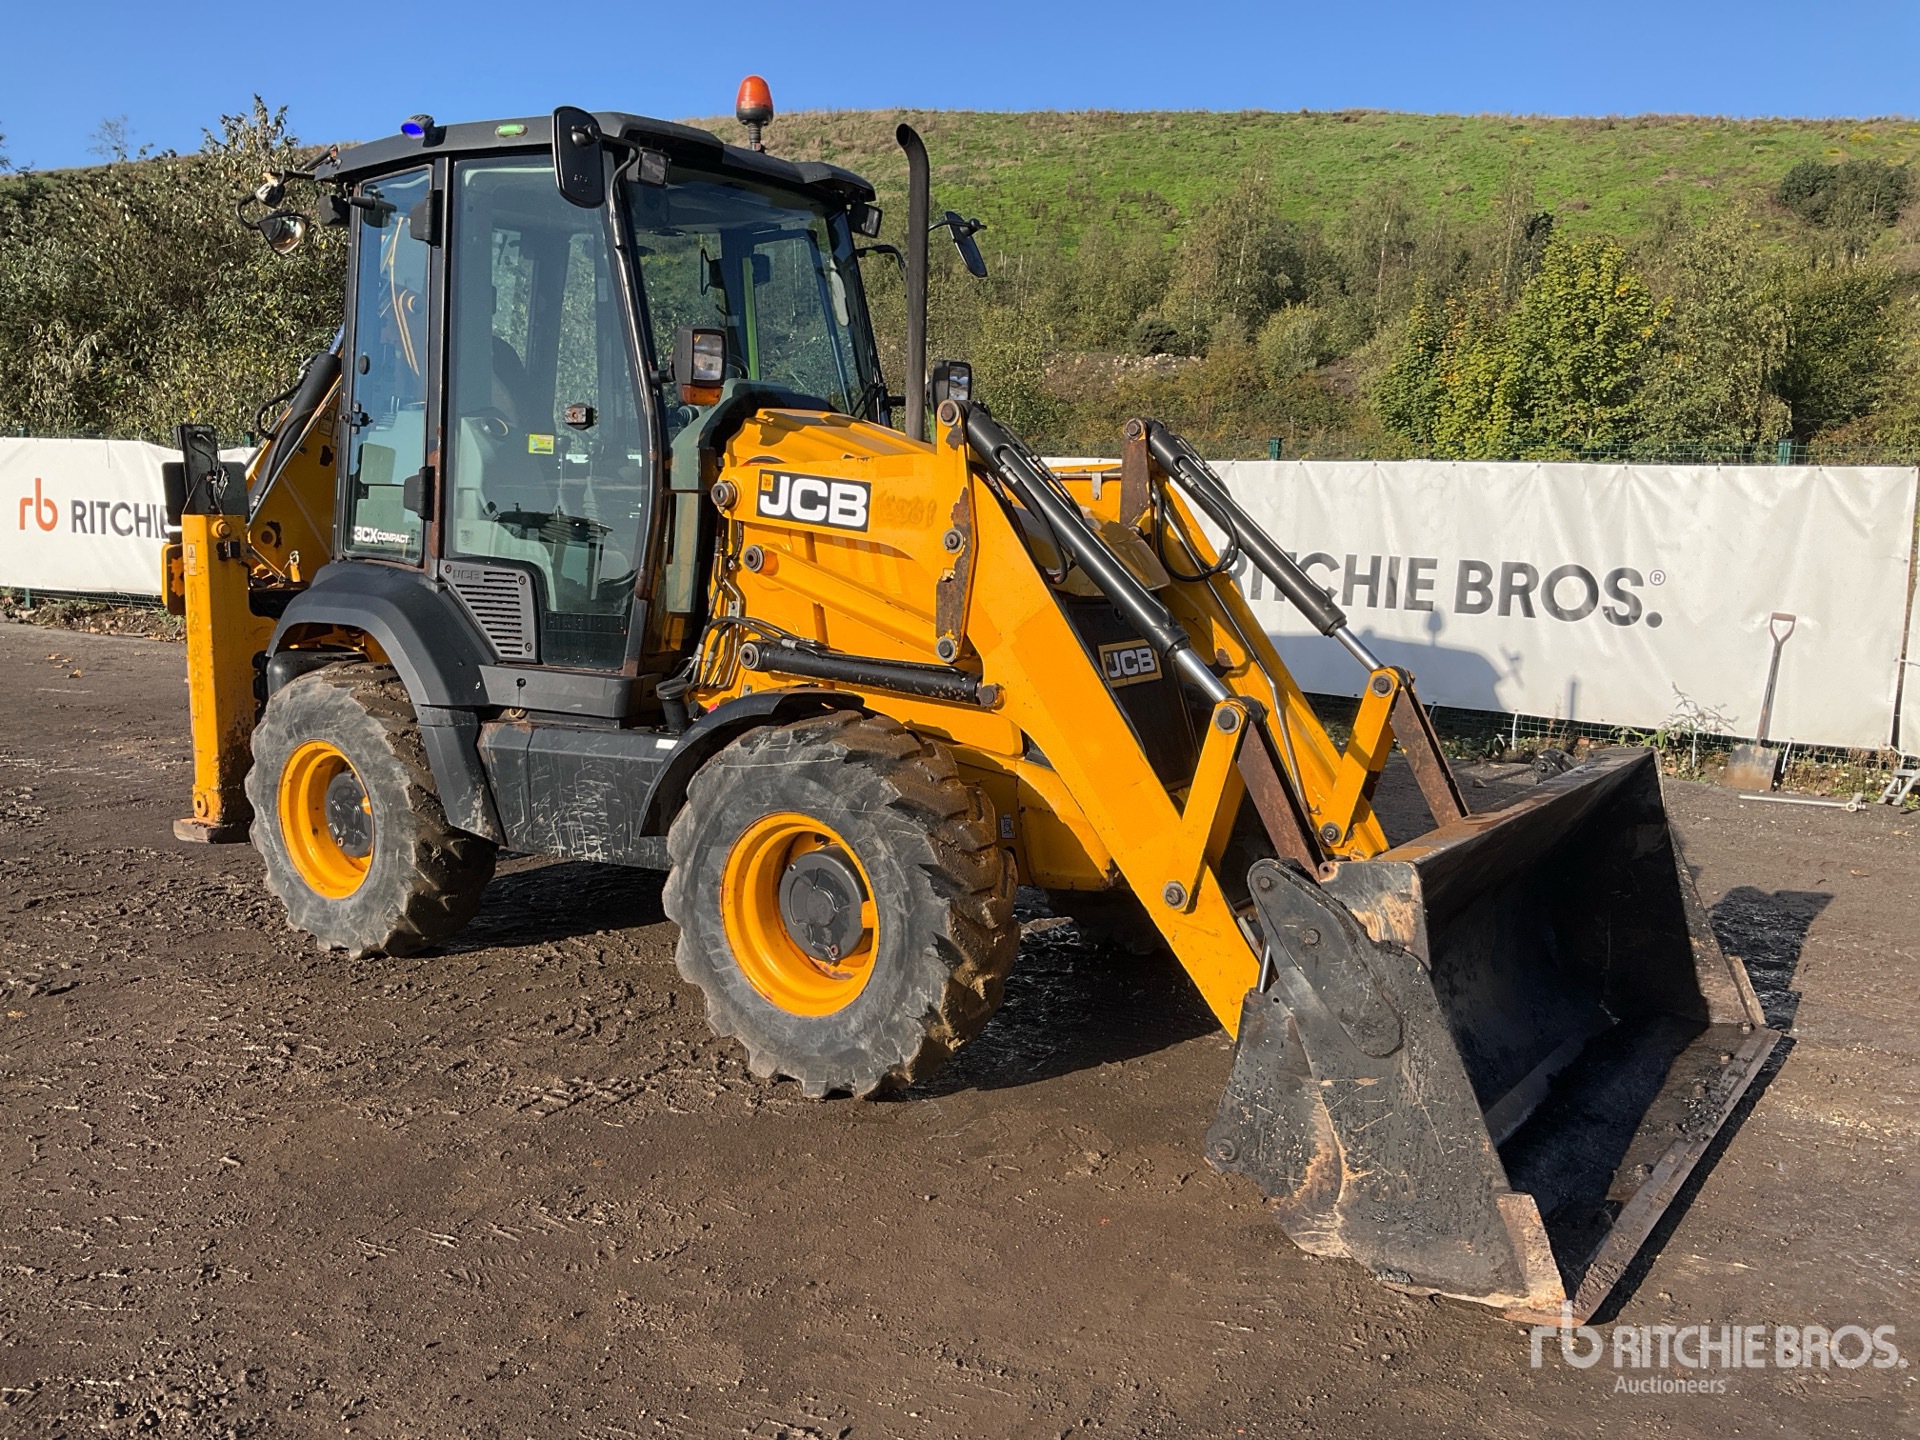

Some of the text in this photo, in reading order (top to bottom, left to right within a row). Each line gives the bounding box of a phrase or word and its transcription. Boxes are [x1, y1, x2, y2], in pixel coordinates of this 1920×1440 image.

[758, 475, 868, 528] JCB
[354, 526, 410, 544] 3CX COMPACT
[1108, 647, 1156, 678] JCB
